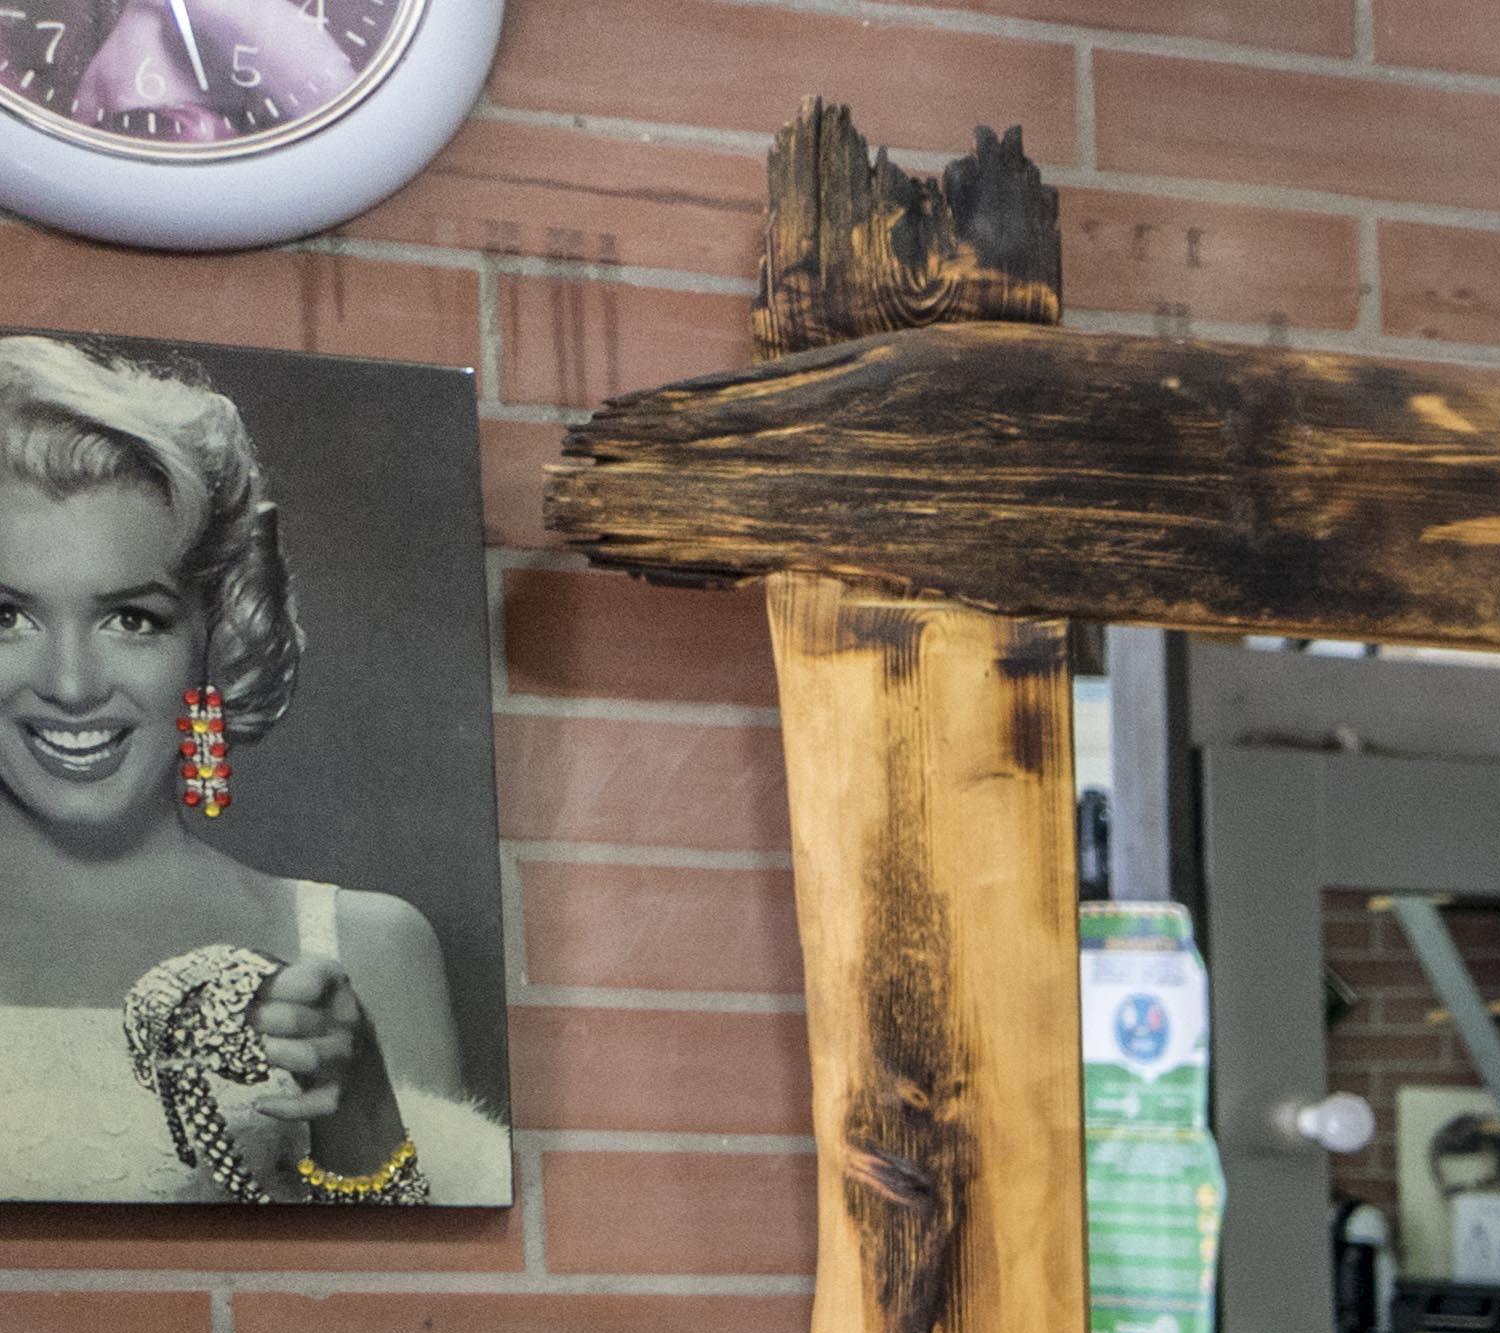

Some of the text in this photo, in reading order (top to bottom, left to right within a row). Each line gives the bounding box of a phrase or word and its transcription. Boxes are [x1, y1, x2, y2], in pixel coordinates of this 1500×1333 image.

[36, 22, 66, 64] 7
[135, 57, 168, 101] 6
[231, 45, 262, 88] 5
